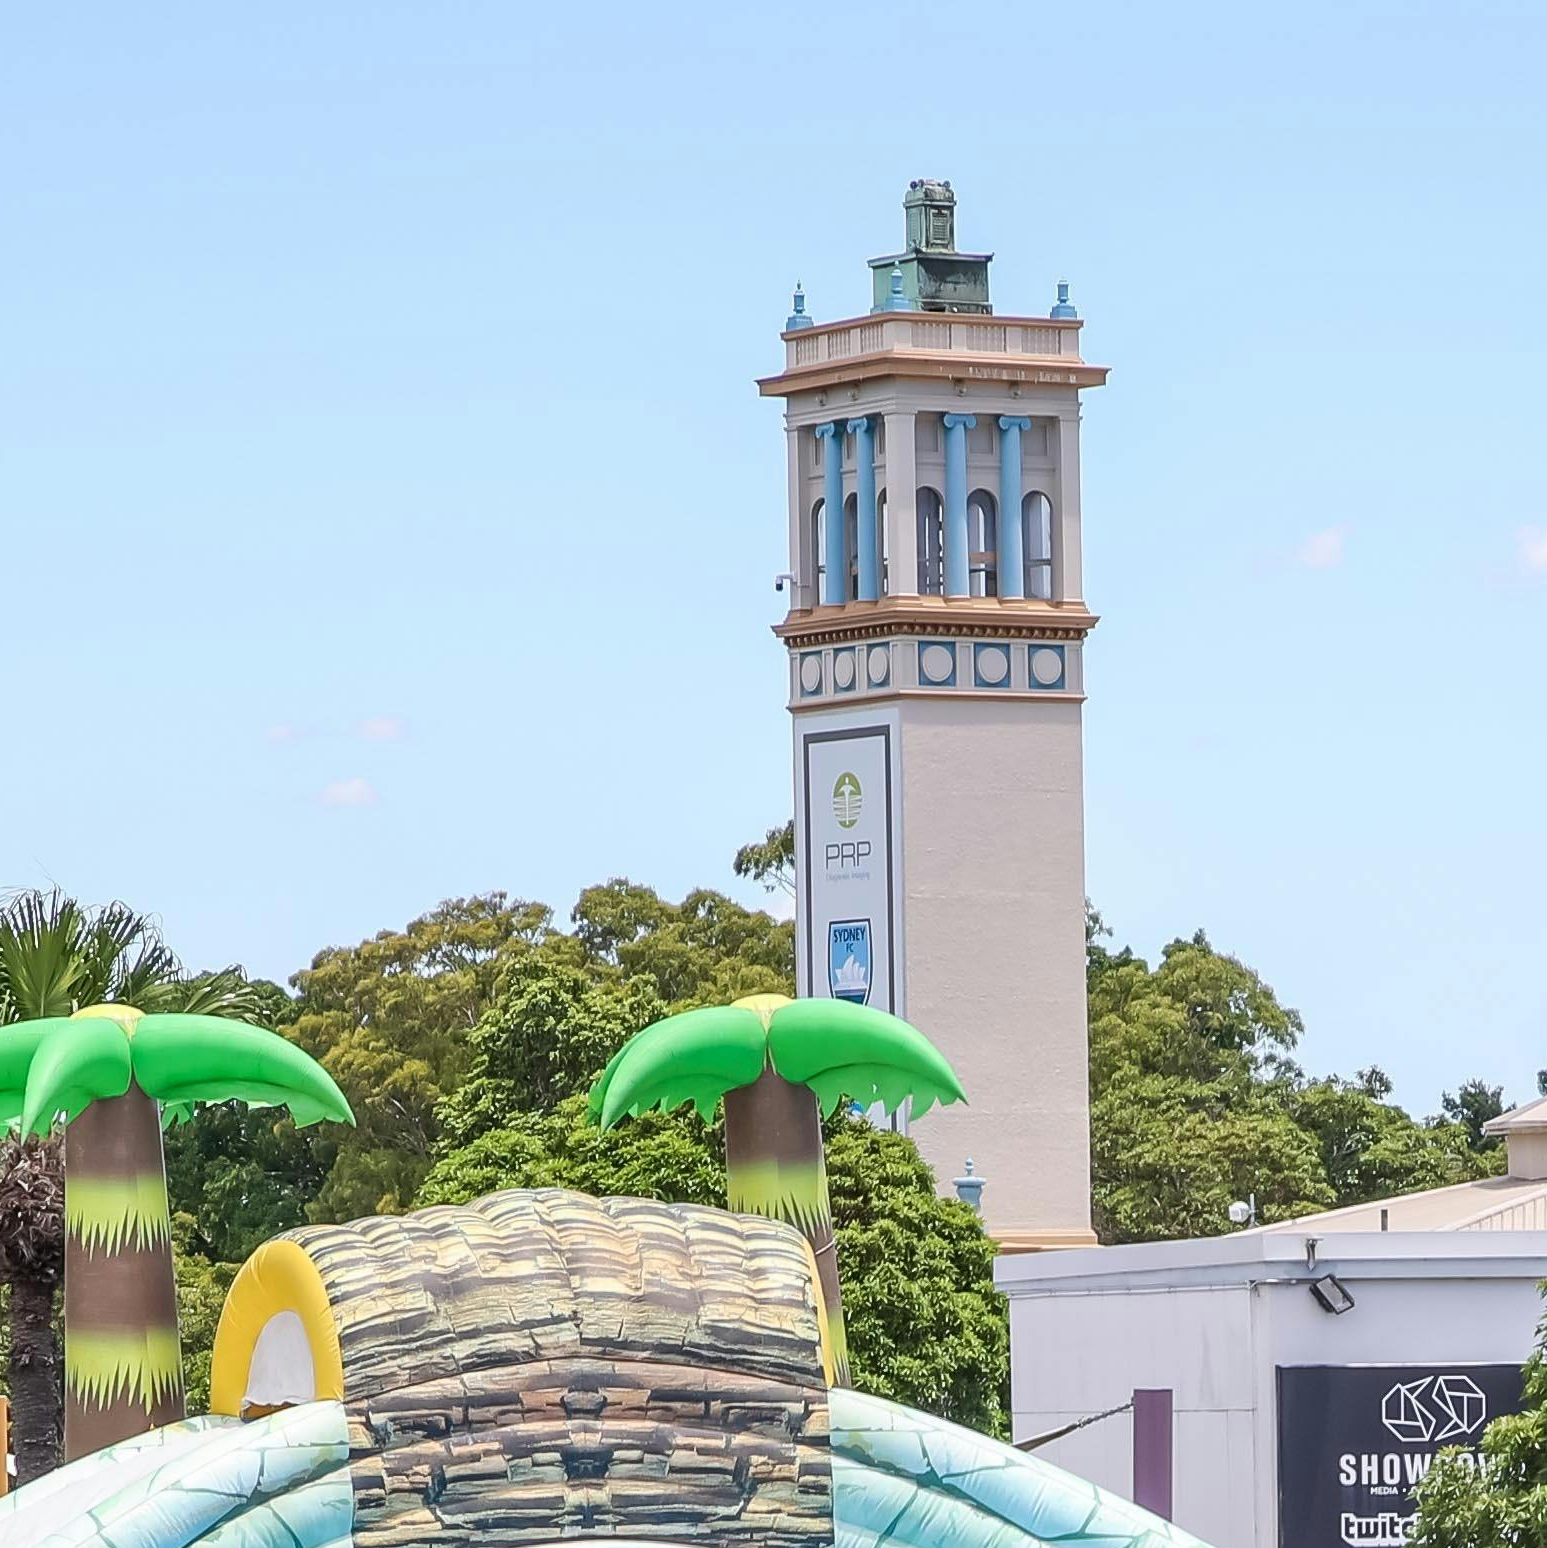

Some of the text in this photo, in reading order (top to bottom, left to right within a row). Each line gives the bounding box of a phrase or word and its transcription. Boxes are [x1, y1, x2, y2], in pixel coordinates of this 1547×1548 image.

[826, 841, 871, 870] PRP
[833, 927, 866, 944] SYDNEY
[1370, 1487, 1398, 1496] MEDIA
[1342, 1514, 1419, 1544] twitc
